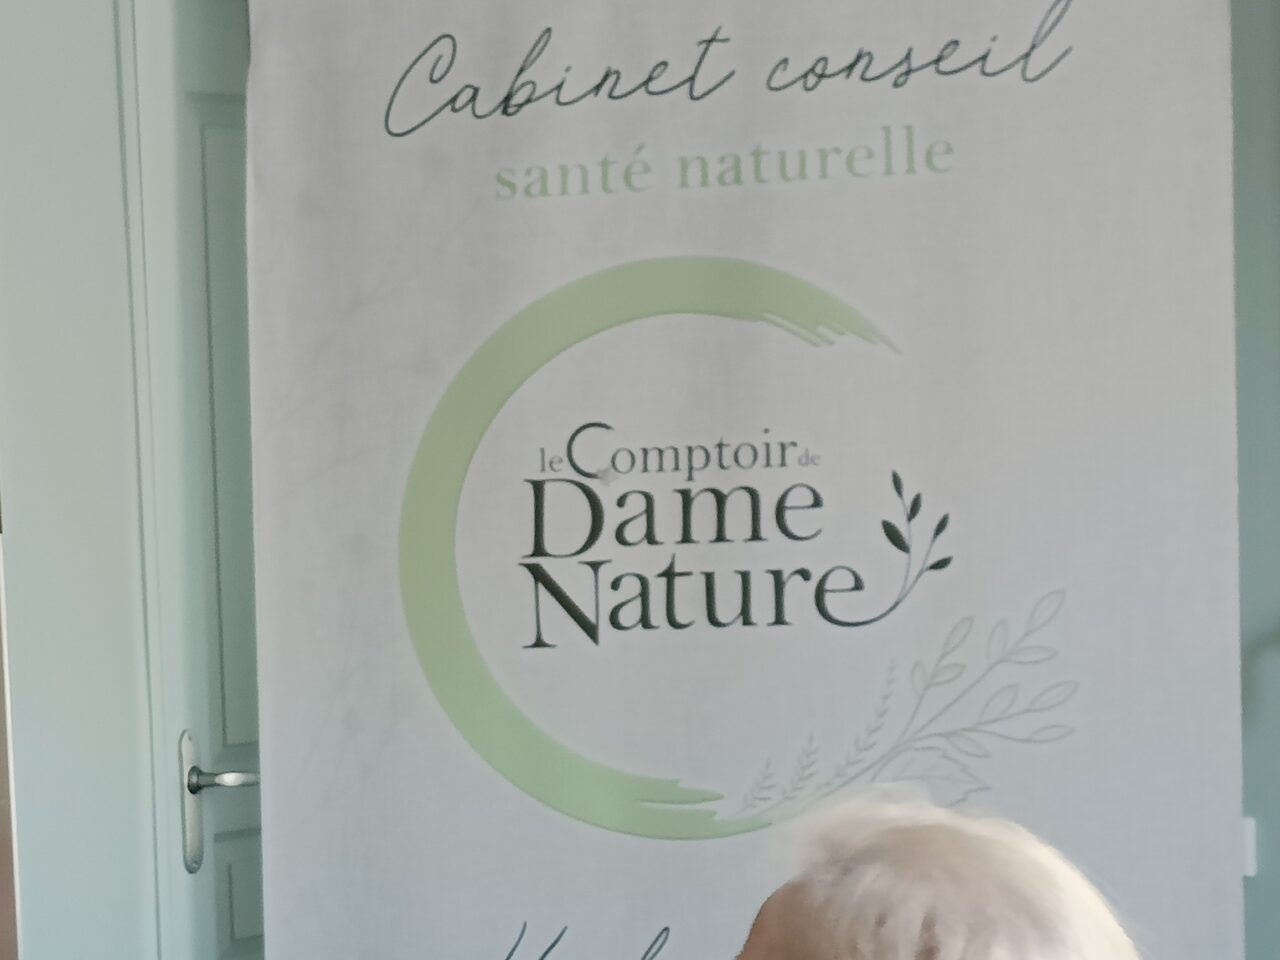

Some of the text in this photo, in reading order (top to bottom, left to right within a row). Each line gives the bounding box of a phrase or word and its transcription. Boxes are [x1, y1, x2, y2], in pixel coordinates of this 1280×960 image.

[384, 0, 1073, 138] Cabinet conseil
[495, 124, 955, 200] santé naturelle
[539, 421, 821, 482] le Comptoir de
[522, 477, 825, 559] Dame
[517, 553, 868, 649] Nature
